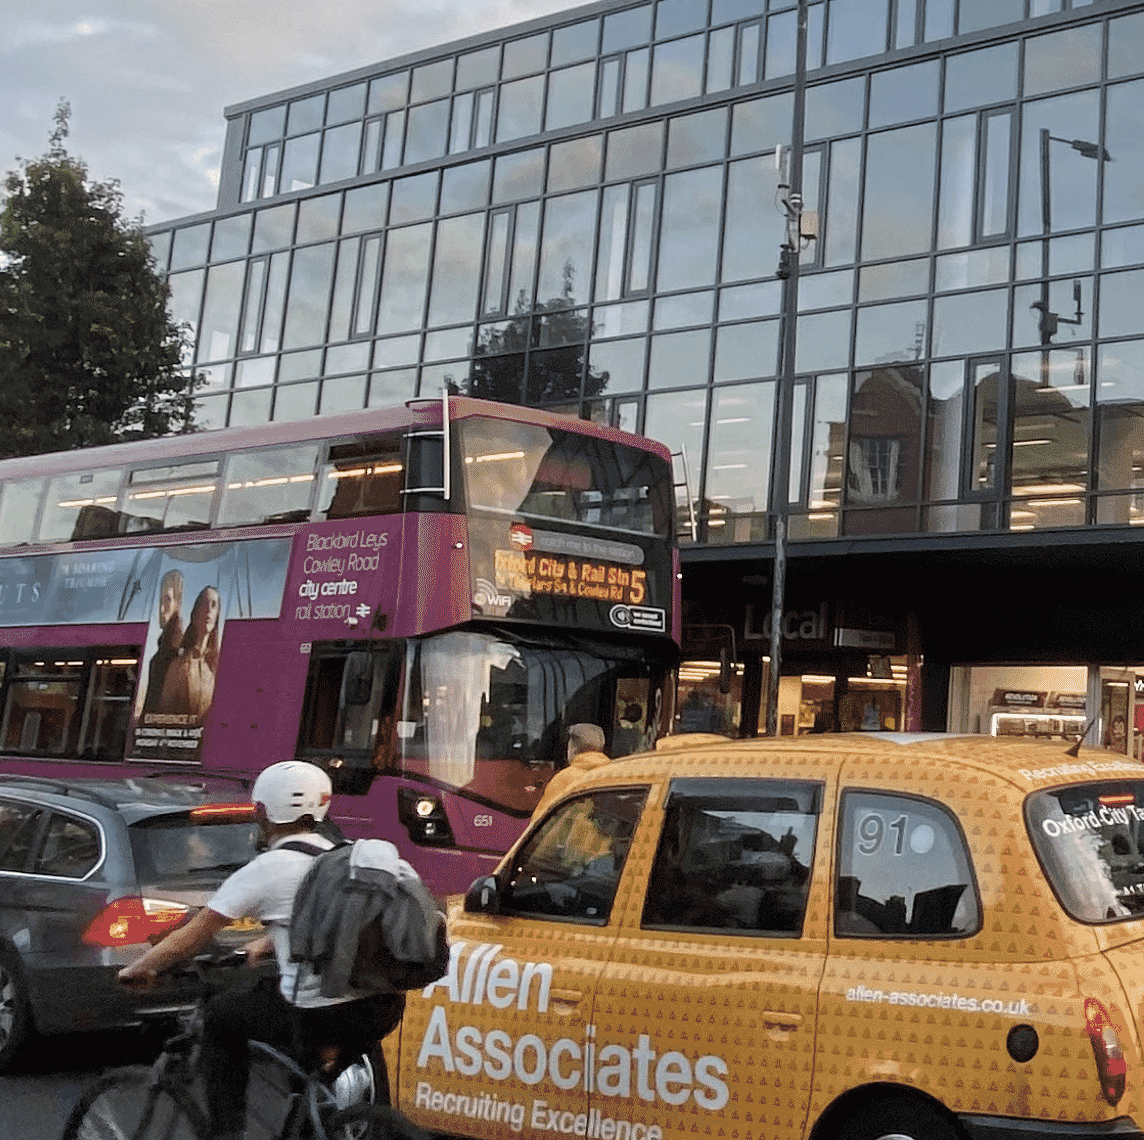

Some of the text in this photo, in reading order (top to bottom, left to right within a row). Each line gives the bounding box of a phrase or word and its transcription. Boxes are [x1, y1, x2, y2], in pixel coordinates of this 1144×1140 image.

[306, 531, 388, 551] Blackbird Leys
[303, 552, 380, 576] Cowley Road
[299, 578, 358, 600] city centre
[539, 558, 565, 578] City
[568, 562, 578, 579] &
[581, 563, 604, 583] Rail
[608, 568, 629, 586] Stn
[629, 570, 646, 604] 5
[610, 586, 623, 600] Rd
[295, 602, 351, 621] rail station
[473, 814, 493, 827] 651
[858, 812, 908, 856] 91
[1042, 809, 1101, 837] Oxford
[1099, 805, 1130, 826] City
[422, 941, 553, 1013] Allen
[846, 985, 1030, 1015] allen-associates.co.uk
[417, 1006, 730, 1110] Associates
[415, 1081, 663, 1140] Recruiting Excellence
